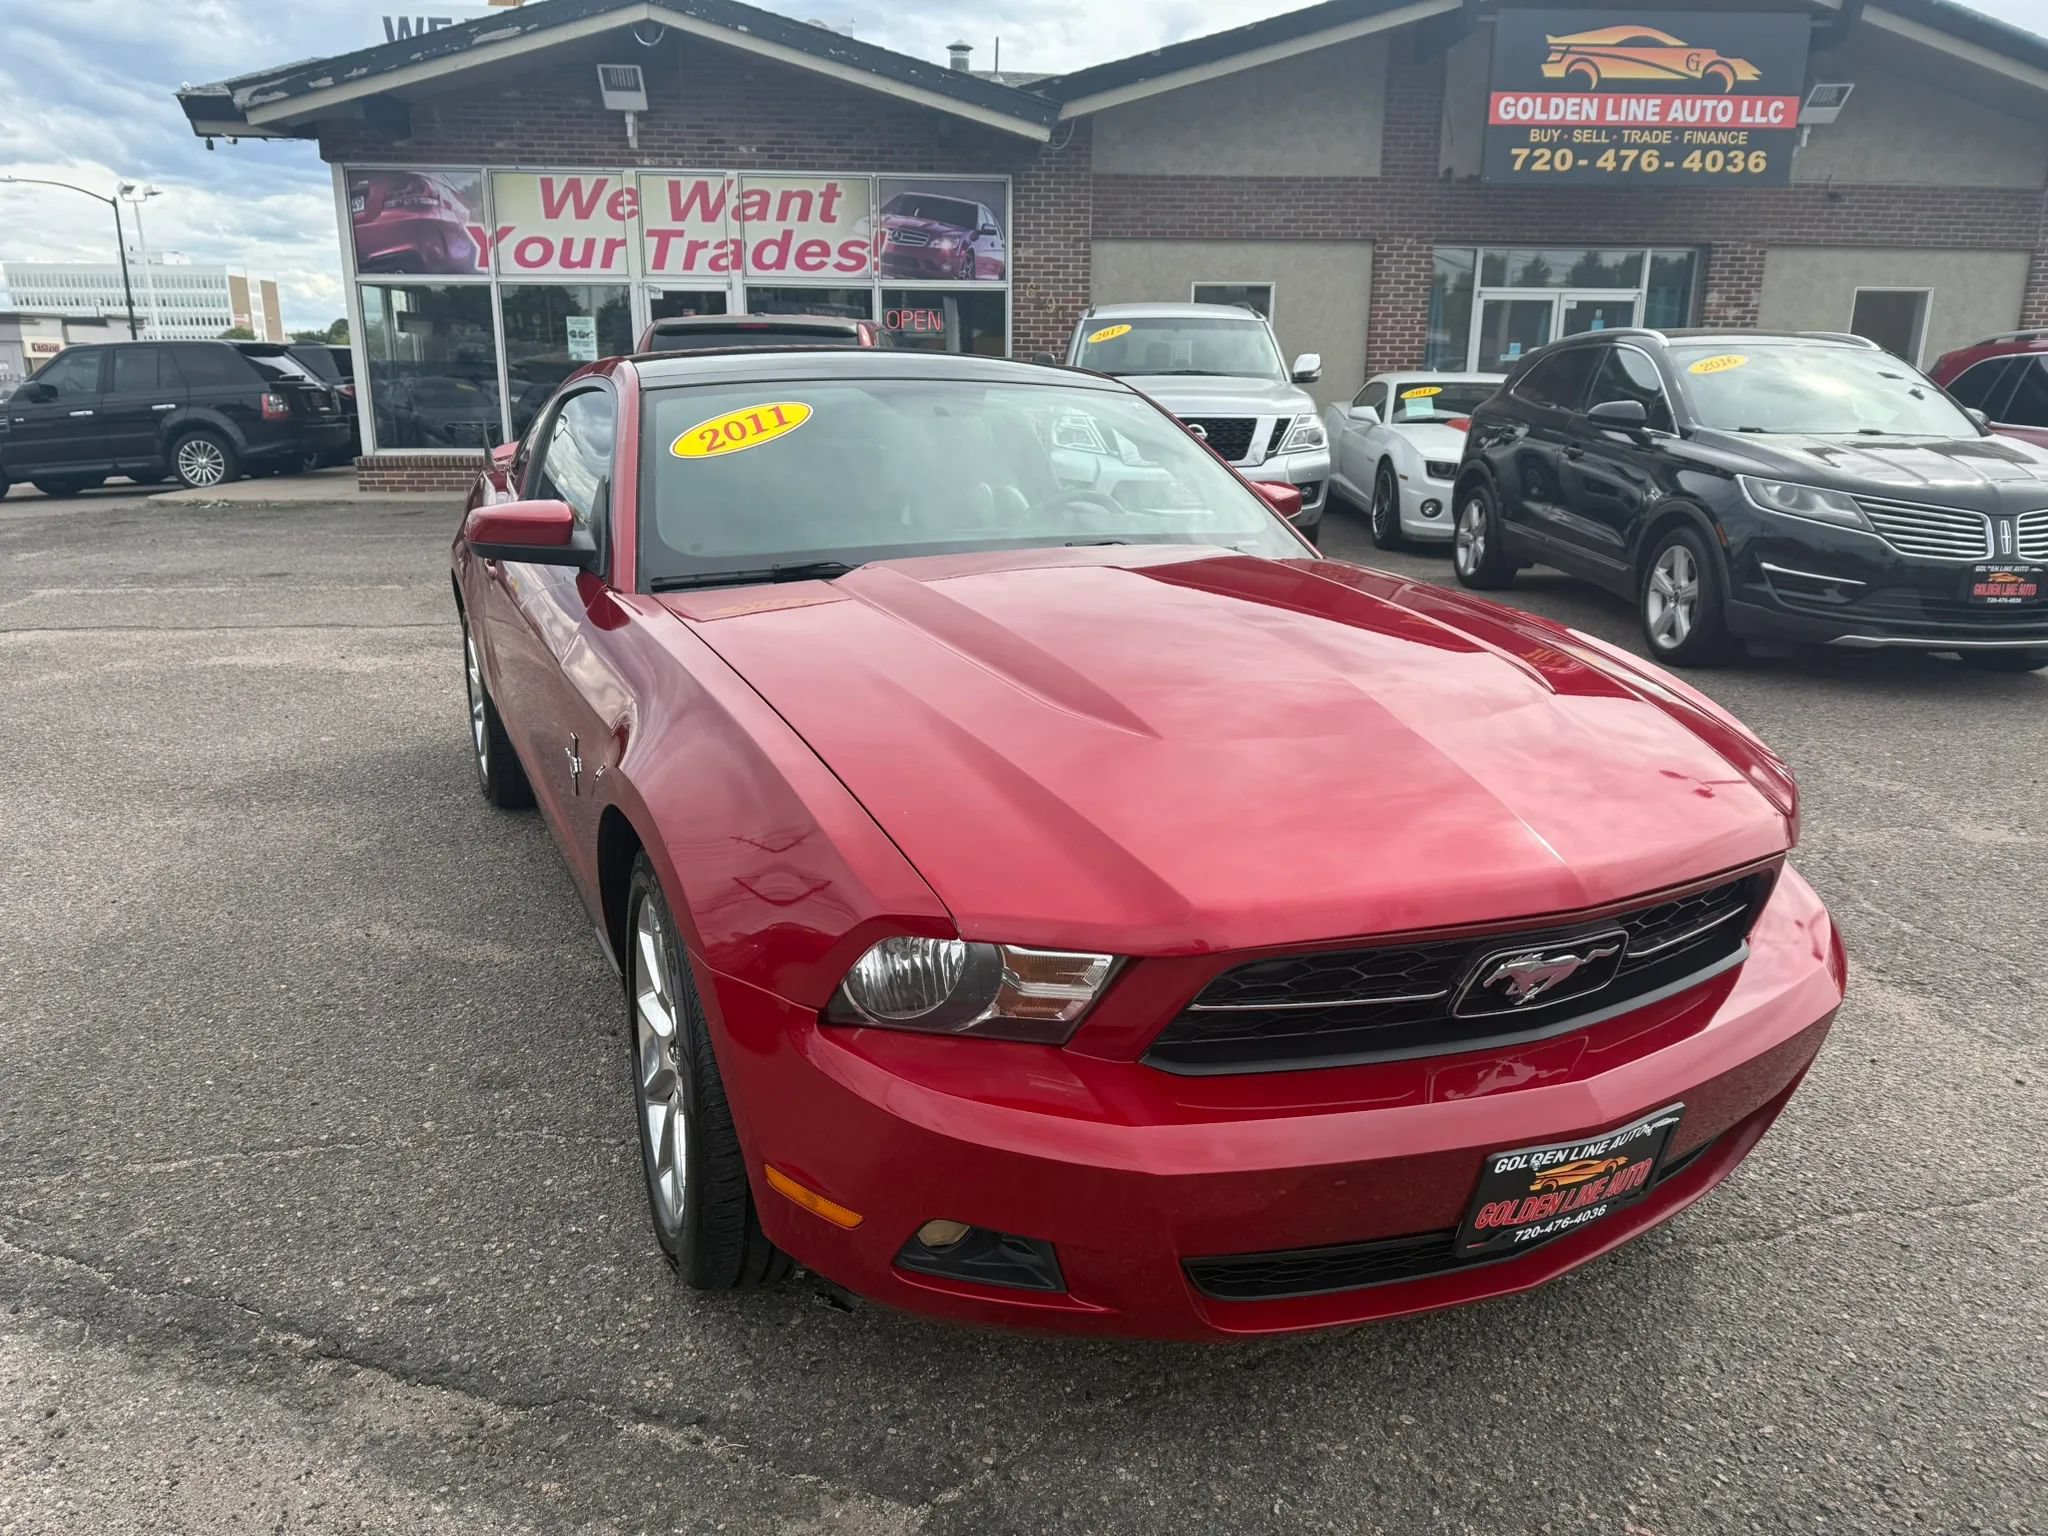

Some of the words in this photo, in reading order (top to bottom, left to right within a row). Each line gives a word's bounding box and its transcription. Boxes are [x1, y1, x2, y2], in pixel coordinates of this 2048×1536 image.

[1498, 96, 1598, 122] GOLDEN
[1605, 98, 1661, 122] LINE
[1666, 99, 1733, 123] AUTO
[1739, 100, 1785, 124] LLC
[1529, 129, 1561, 143] BUY
[1572, 129, 1610, 143] SELL
[1622, 130, 1672, 144] TRADE
[1683, 131, 1748, 145] FINANCE
[1510, 147, 1768, 173] 720-476-4036
[539, 177, 640, 221] We
[667, 179, 842, 224] Want
[465, 225, 627, 269] Your
[645, 229, 887, 273] Trades!
[885, 309, 942, 331] OPEN
[1700, 356, 1738, 372] 2016
[699, 405, 792, 452] 2011
[1494, 1149, 1571, 1174] GOLDEN
[1570, 1139, 1611, 1161] LINE
[1609, 1124, 1649, 1150] AUTO
[1474, 1190, 1567, 1230] GOLDEN
[1561, 1176, 1610, 1213] LINE
[1601, 1158, 1653, 1200] AUTO
[1513, 1204, 1608, 1243] 720-476-4036
